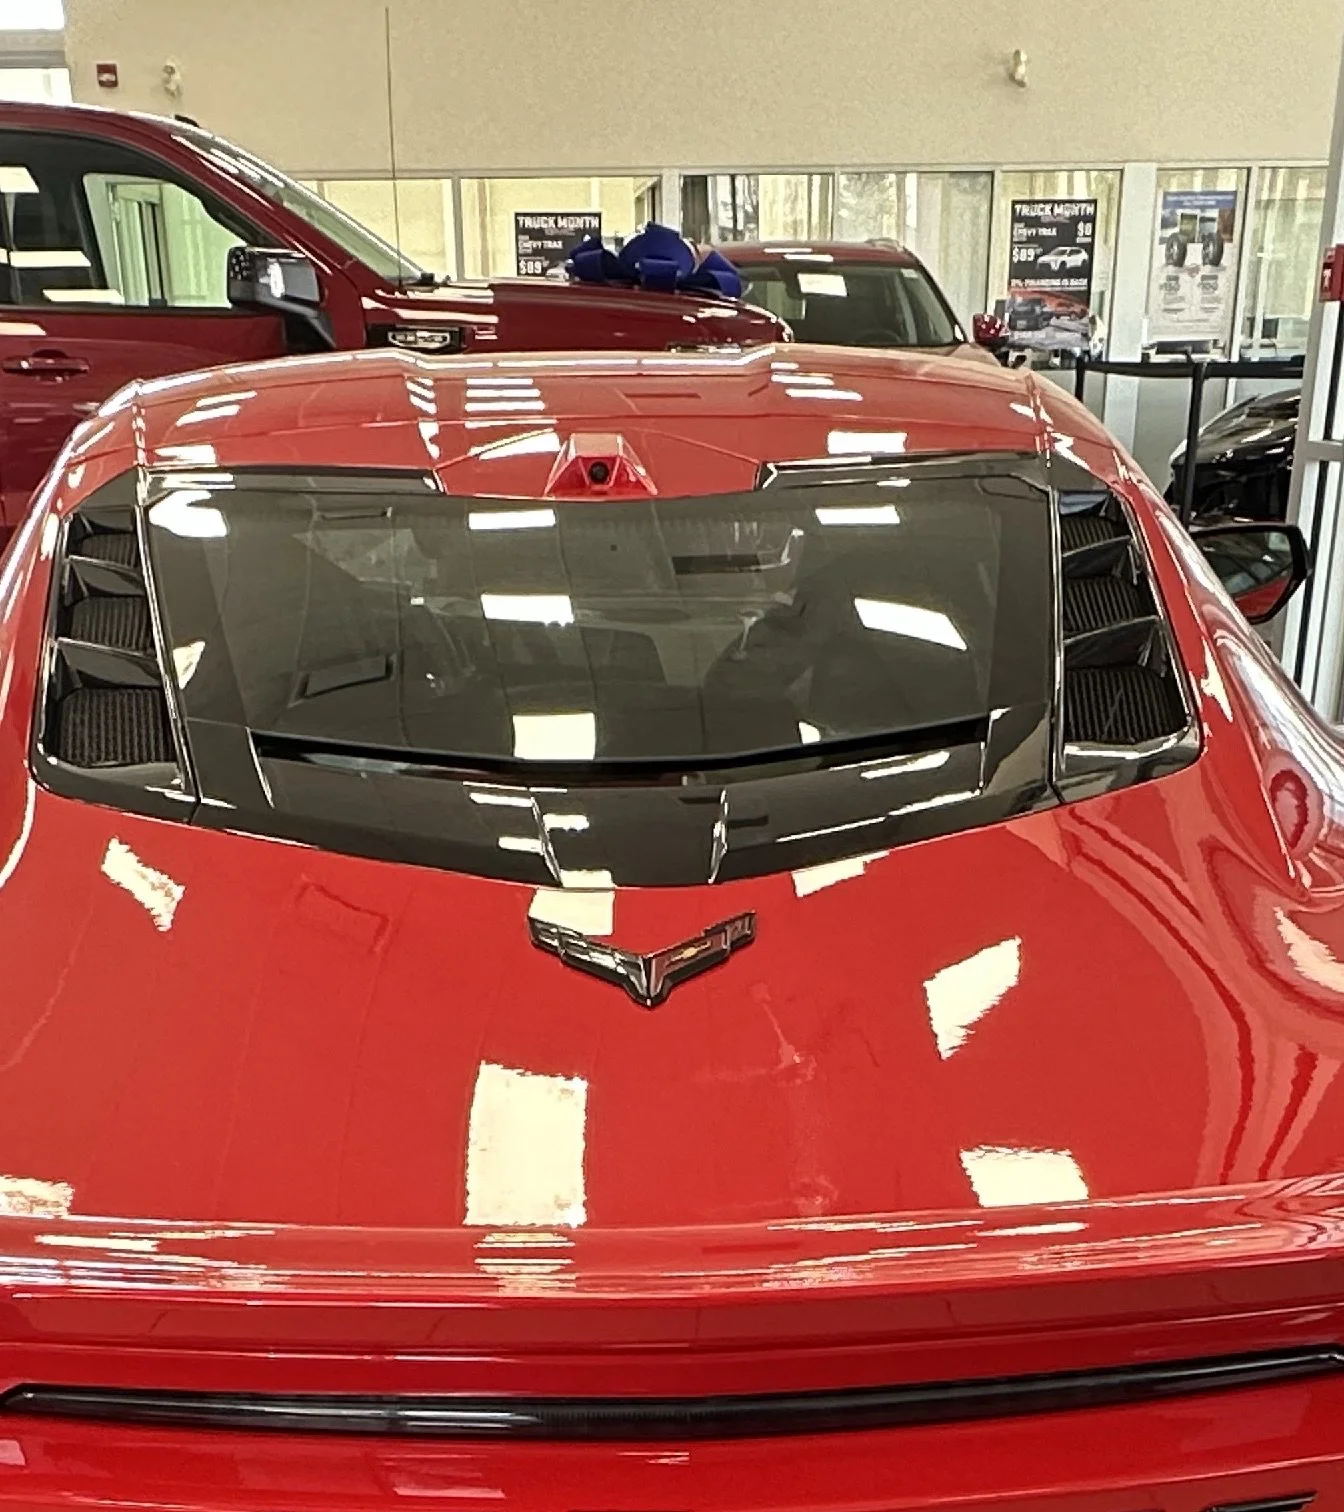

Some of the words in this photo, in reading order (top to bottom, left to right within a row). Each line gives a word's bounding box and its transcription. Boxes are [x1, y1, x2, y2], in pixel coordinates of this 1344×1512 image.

[1014, 203, 1052, 217] TRUCK
[1053, 202, 1095, 217] MONTH
[517, 216, 556, 229] TRUCK
[557, 215, 599, 229] MONTH
